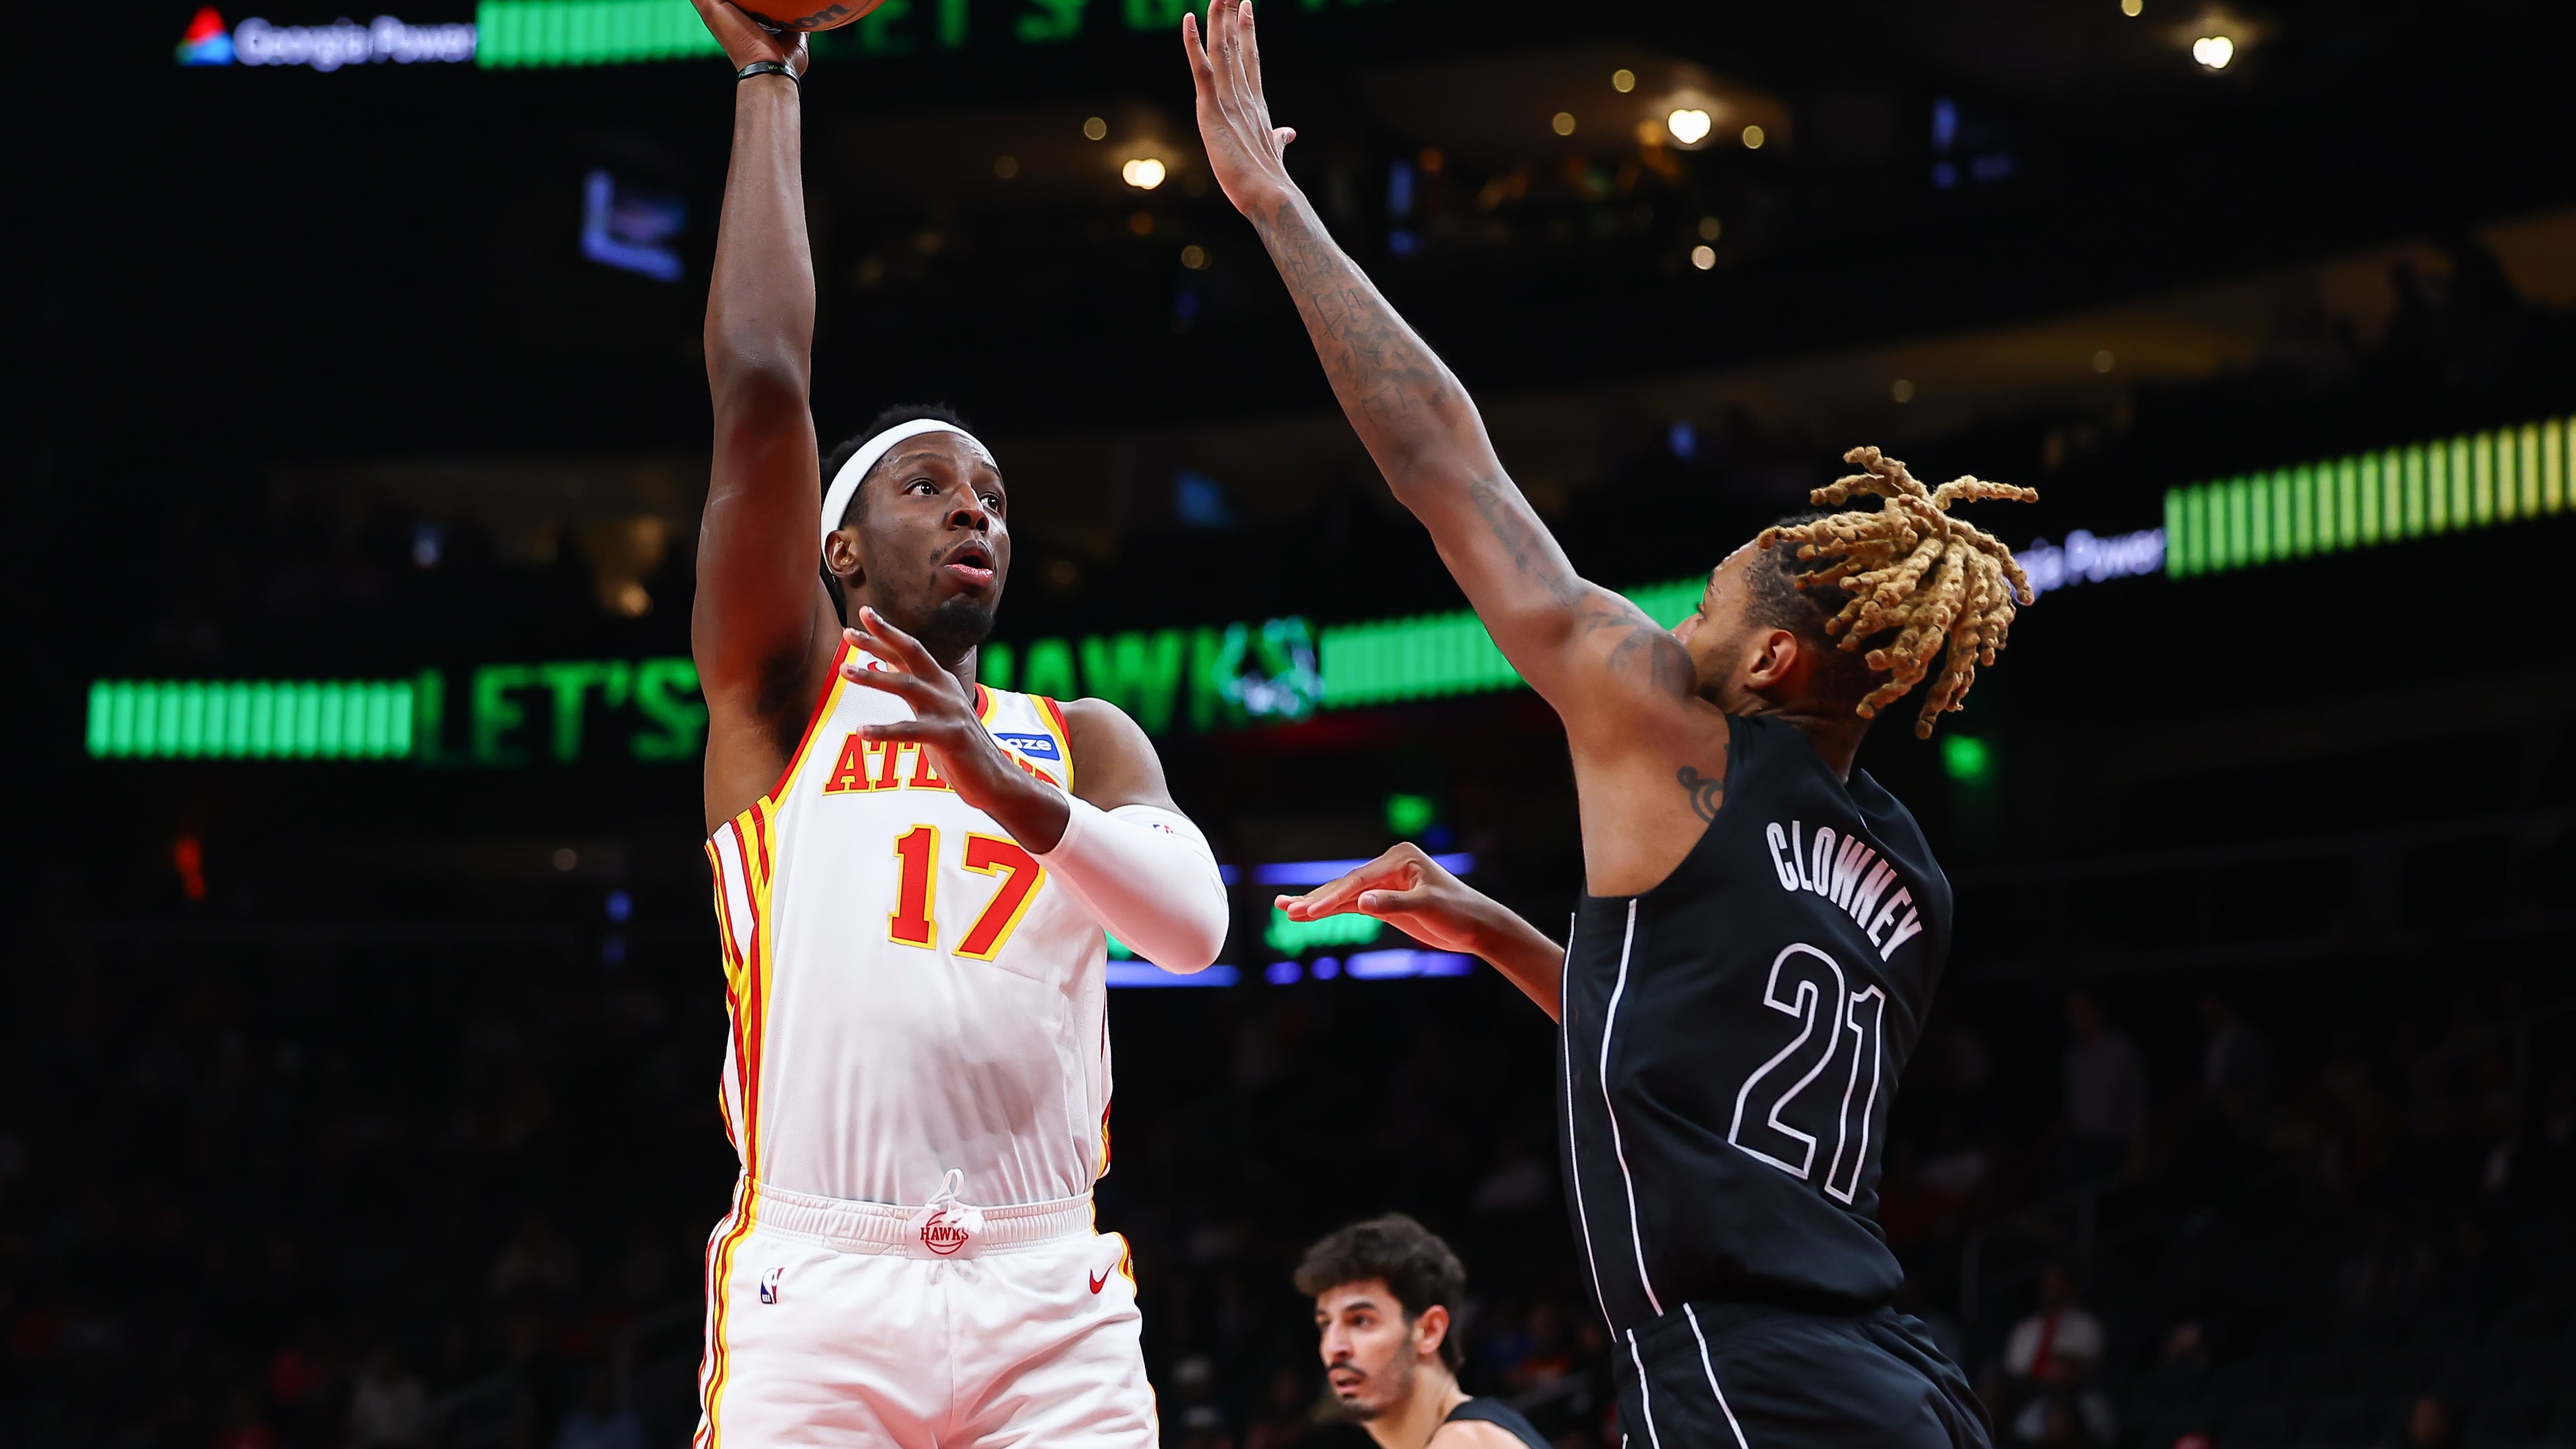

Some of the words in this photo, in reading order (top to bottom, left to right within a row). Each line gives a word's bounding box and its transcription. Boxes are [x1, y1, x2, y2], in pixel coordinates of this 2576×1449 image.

[415, 656, 710, 769] LET'S
[888, 823, 1046, 961] 17
[1766, 820, 1923, 962] CLOWNEY
[1727, 943, 1886, 1205] 21
[920, 1226, 969, 1241] HAWKS
